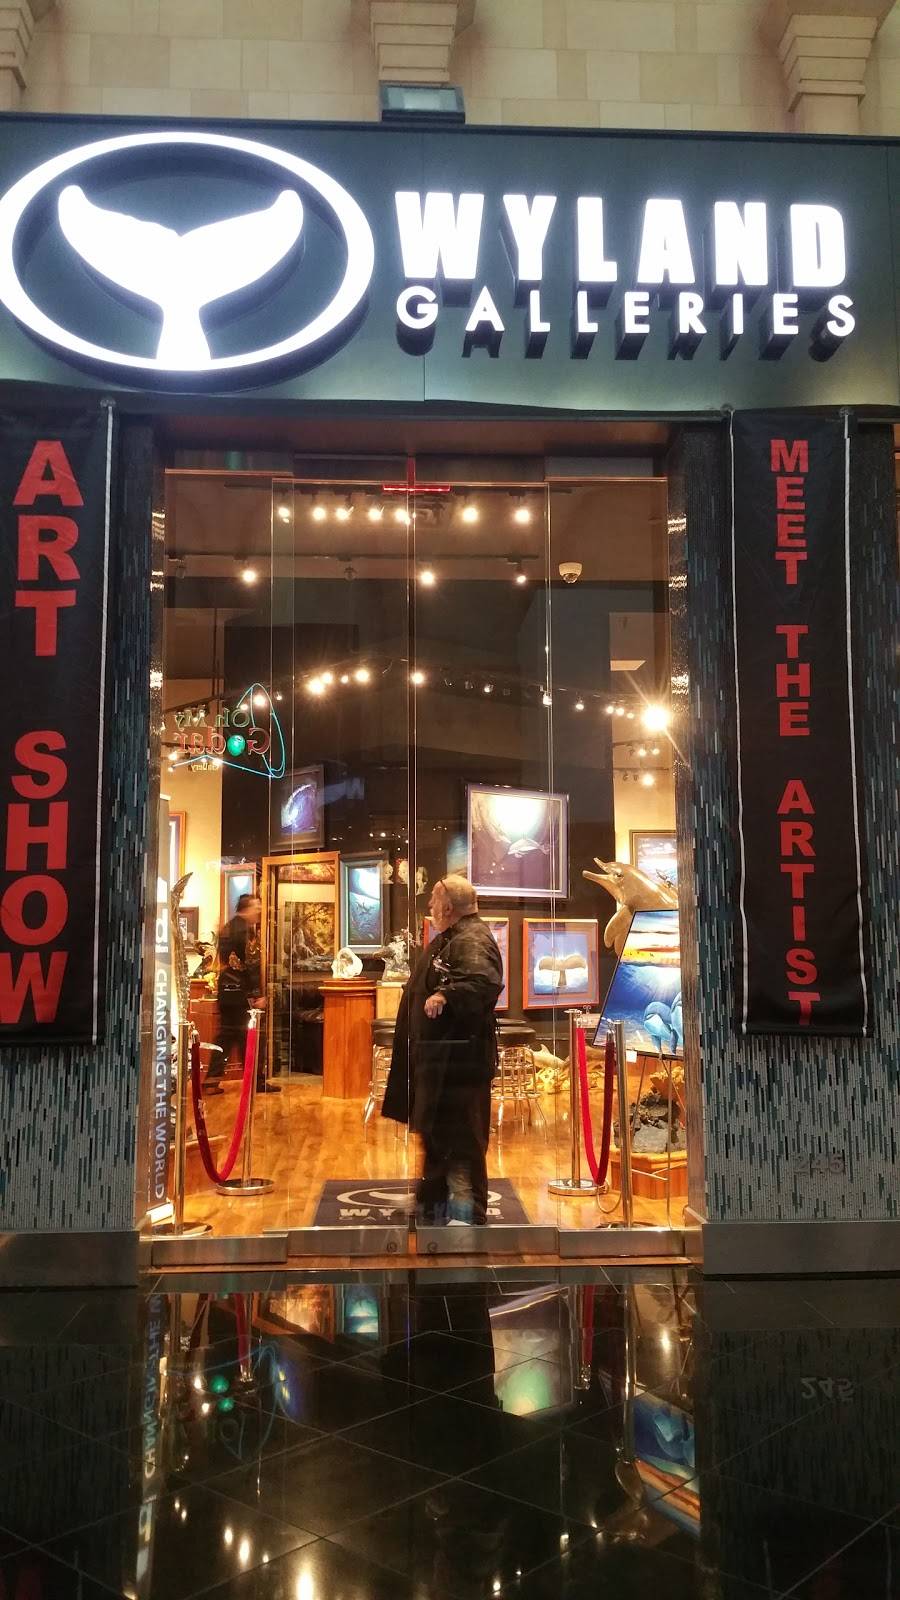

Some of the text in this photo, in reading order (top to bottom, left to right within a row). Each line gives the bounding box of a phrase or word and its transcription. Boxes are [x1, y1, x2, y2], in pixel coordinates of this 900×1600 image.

[394, 190, 847, 288] WYLAND
[396, 285, 856, 337] GALLERIES
[0, 440, 83, 1025] ART SHOW
[769, 439, 820, 1026] MEET THE ARTIST
[154, 968, 168, 1077] CHANGING
[155, 1079, 167, 1119] THE
[154, 1122, 167, 1200] WORLD
